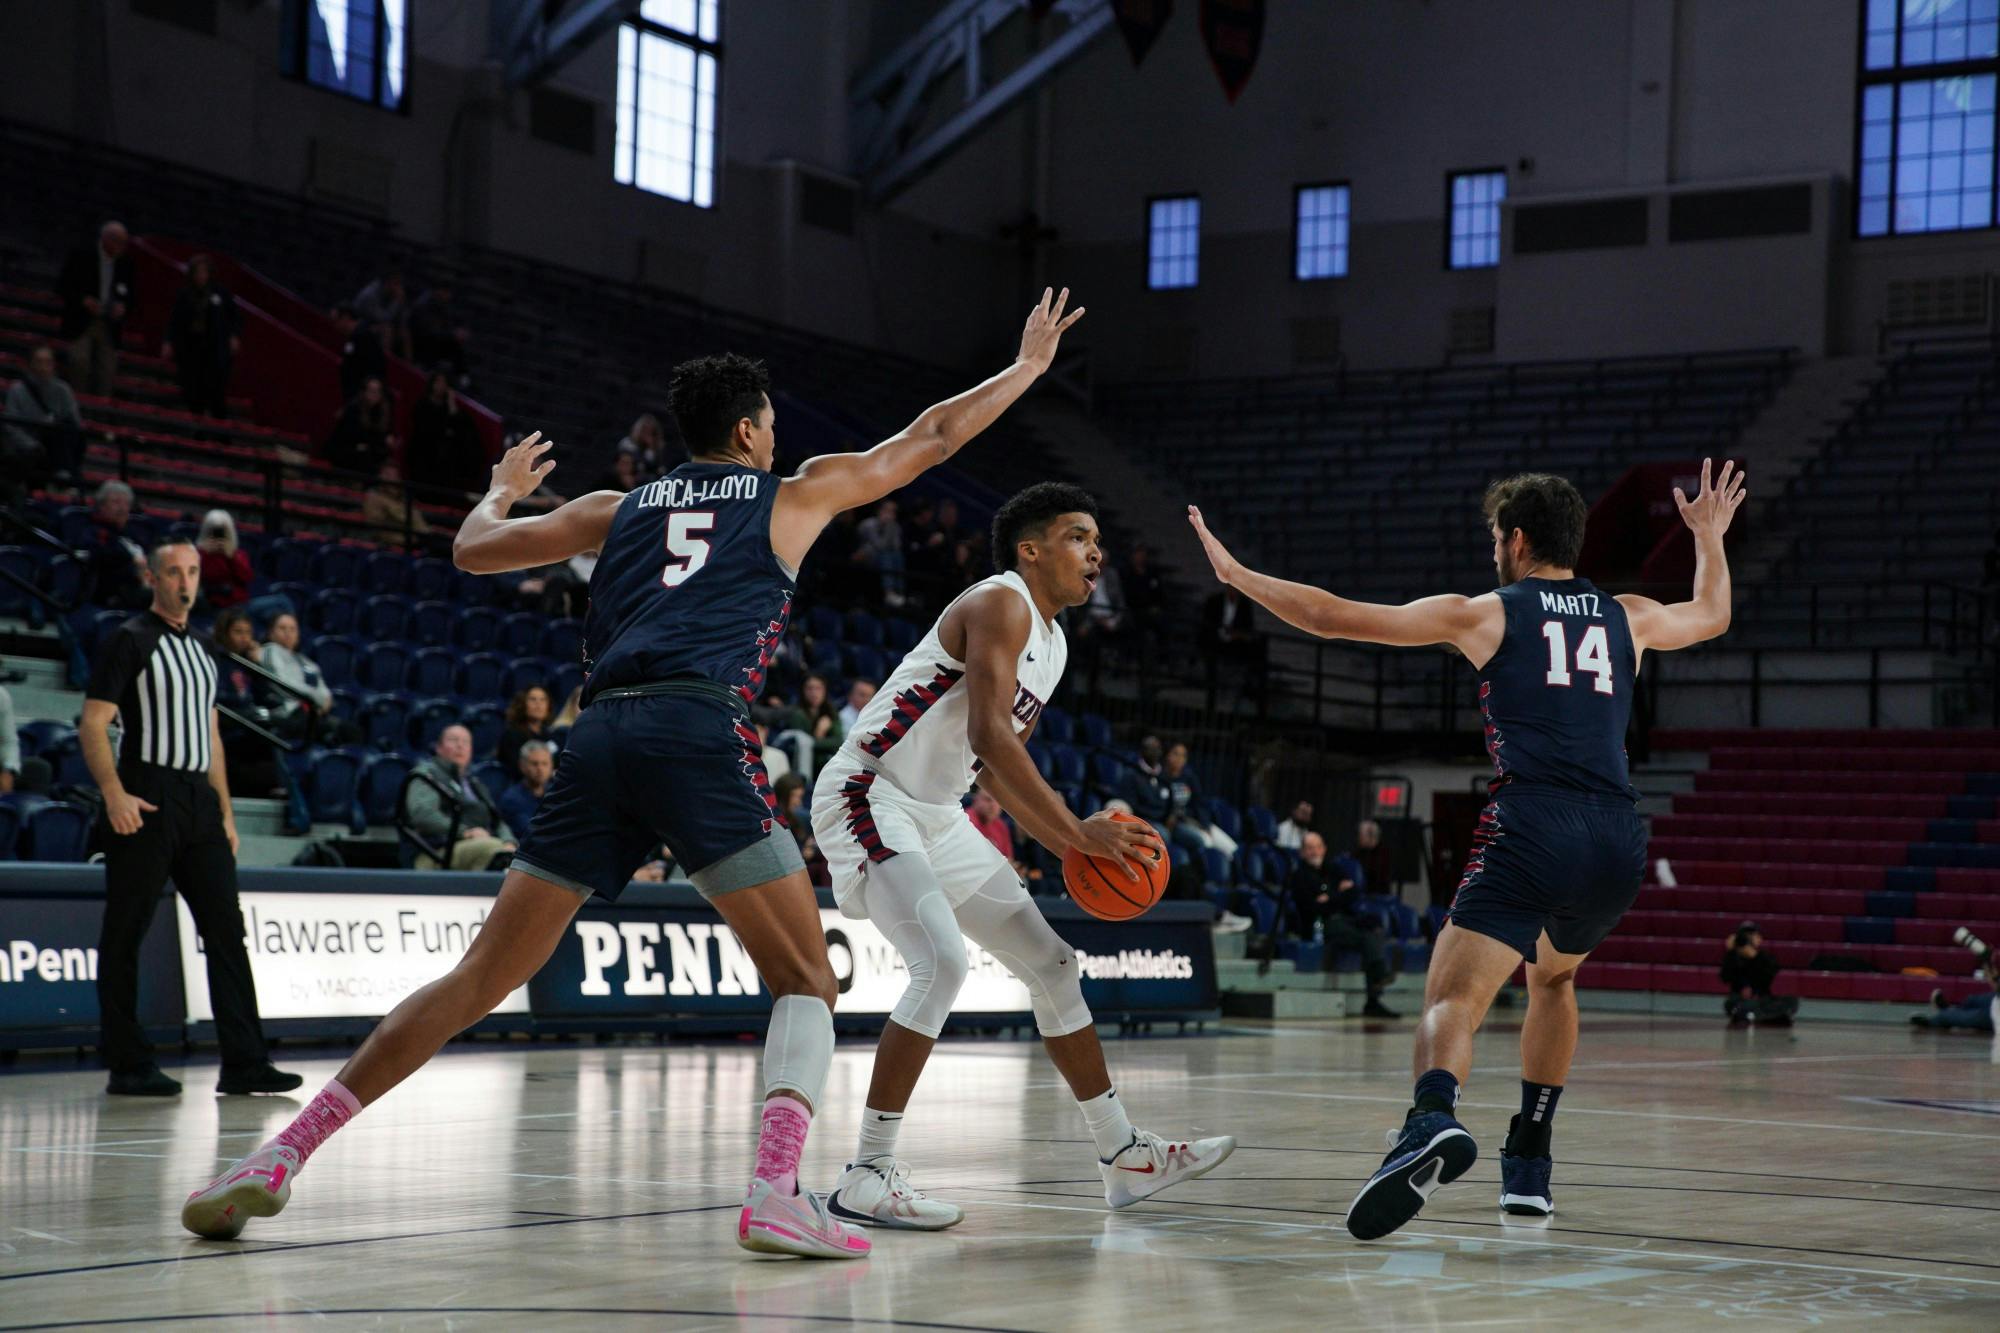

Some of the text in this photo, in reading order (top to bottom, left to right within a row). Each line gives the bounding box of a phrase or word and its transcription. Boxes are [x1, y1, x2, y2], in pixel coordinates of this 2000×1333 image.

[638, 474, 759, 509] LORCA-LLOYD
[661, 511, 716, 588] 5
[1539, 591, 1603, 618] MARTZ
[1541, 619, 1614, 696] 14
[197, 906, 384, 953] laware
[575, 920, 761, 996] PENN
[1075, 948, 1194, 979] PennAthletics
[289, 977, 312, 1003] by
